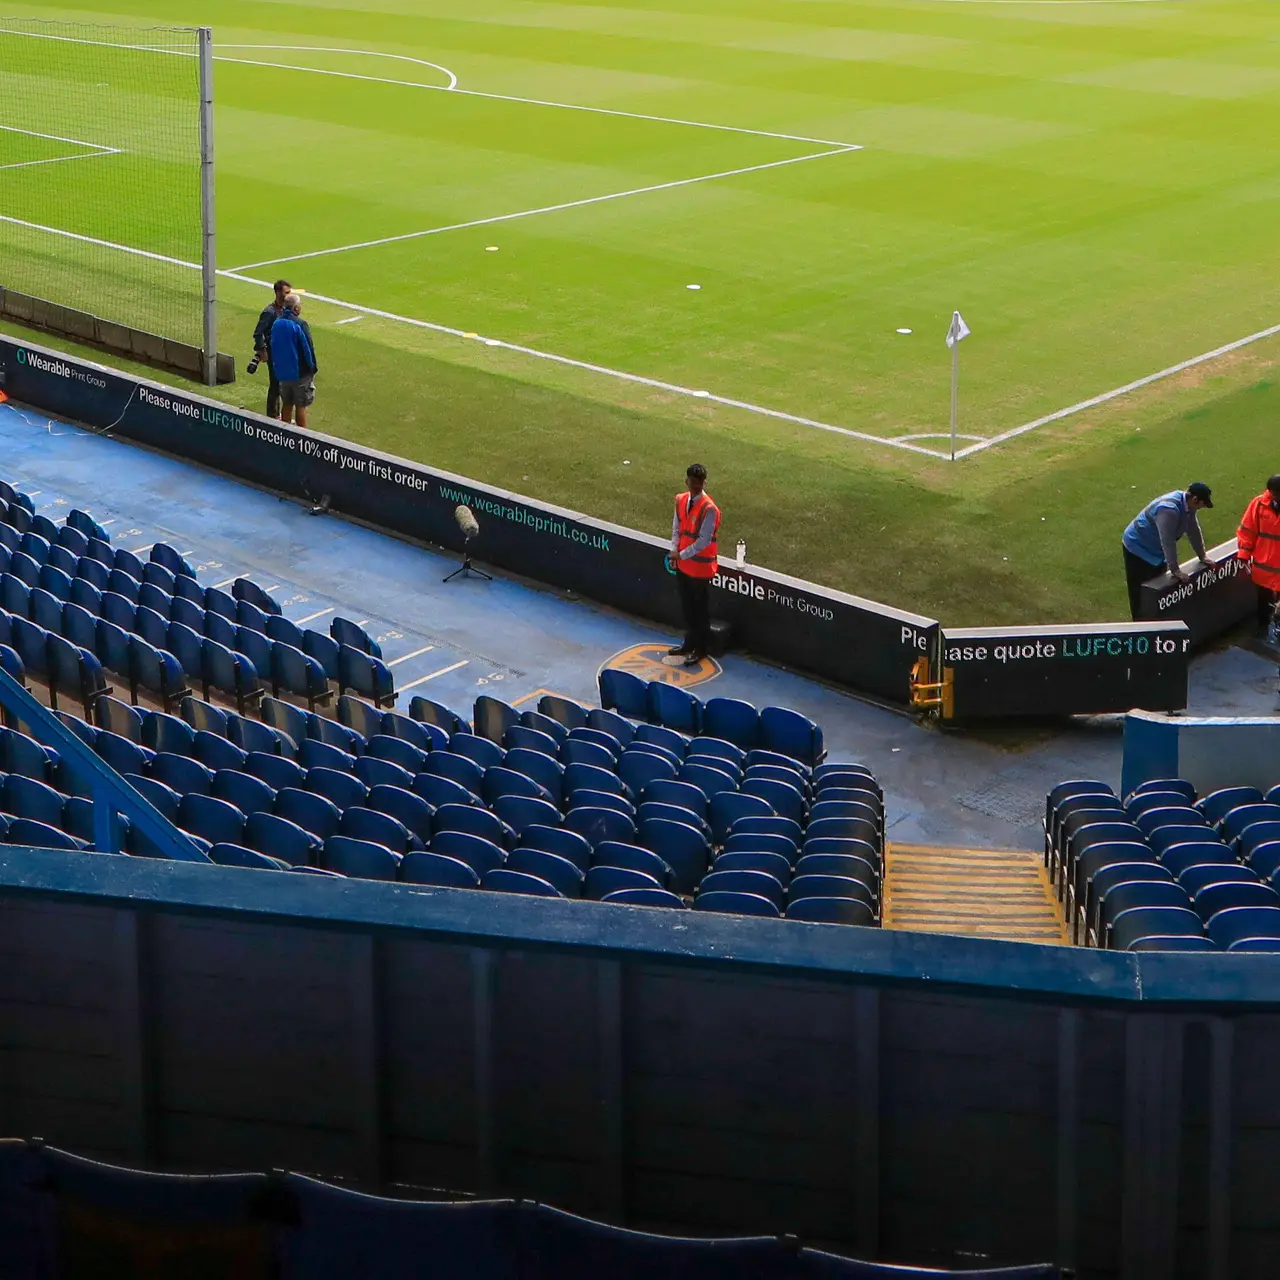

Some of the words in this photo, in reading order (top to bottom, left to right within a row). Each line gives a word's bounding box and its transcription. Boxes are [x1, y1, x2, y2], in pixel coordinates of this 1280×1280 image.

[27, 351, 70, 379] Wearable
[71, 368, 85, 383] Print
[86, 373, 107, 389] Group
[139, 388, 171, 410] Please
[172, 400, 200, 420] quote
[202, 408, 242, 433] LUFC10
[244, 421, 255, 437] to
[256, 426, 295, 450] receive
[297, 439, 322, 458] 10%
[323, 447, 339, 464] off
[340, 452, 367, 473] your
[368, 460, 393, 482] first
[394, 471, 429, 492] order
[439, 484, 611, 552] www.wearableprint.co.uk
[709, 572, 765, 600] arable
[767, 588, 794, 609] Print
[797, 598, 834, 621] Group
[1195, 568, 1218, 592] 10%
[1218, 559, 1233, 580] off
[994, 640, 1057, 664] quote
[1062, 636, 1149, 658] LUFC10
[1155, 635, 1176, 654] to
